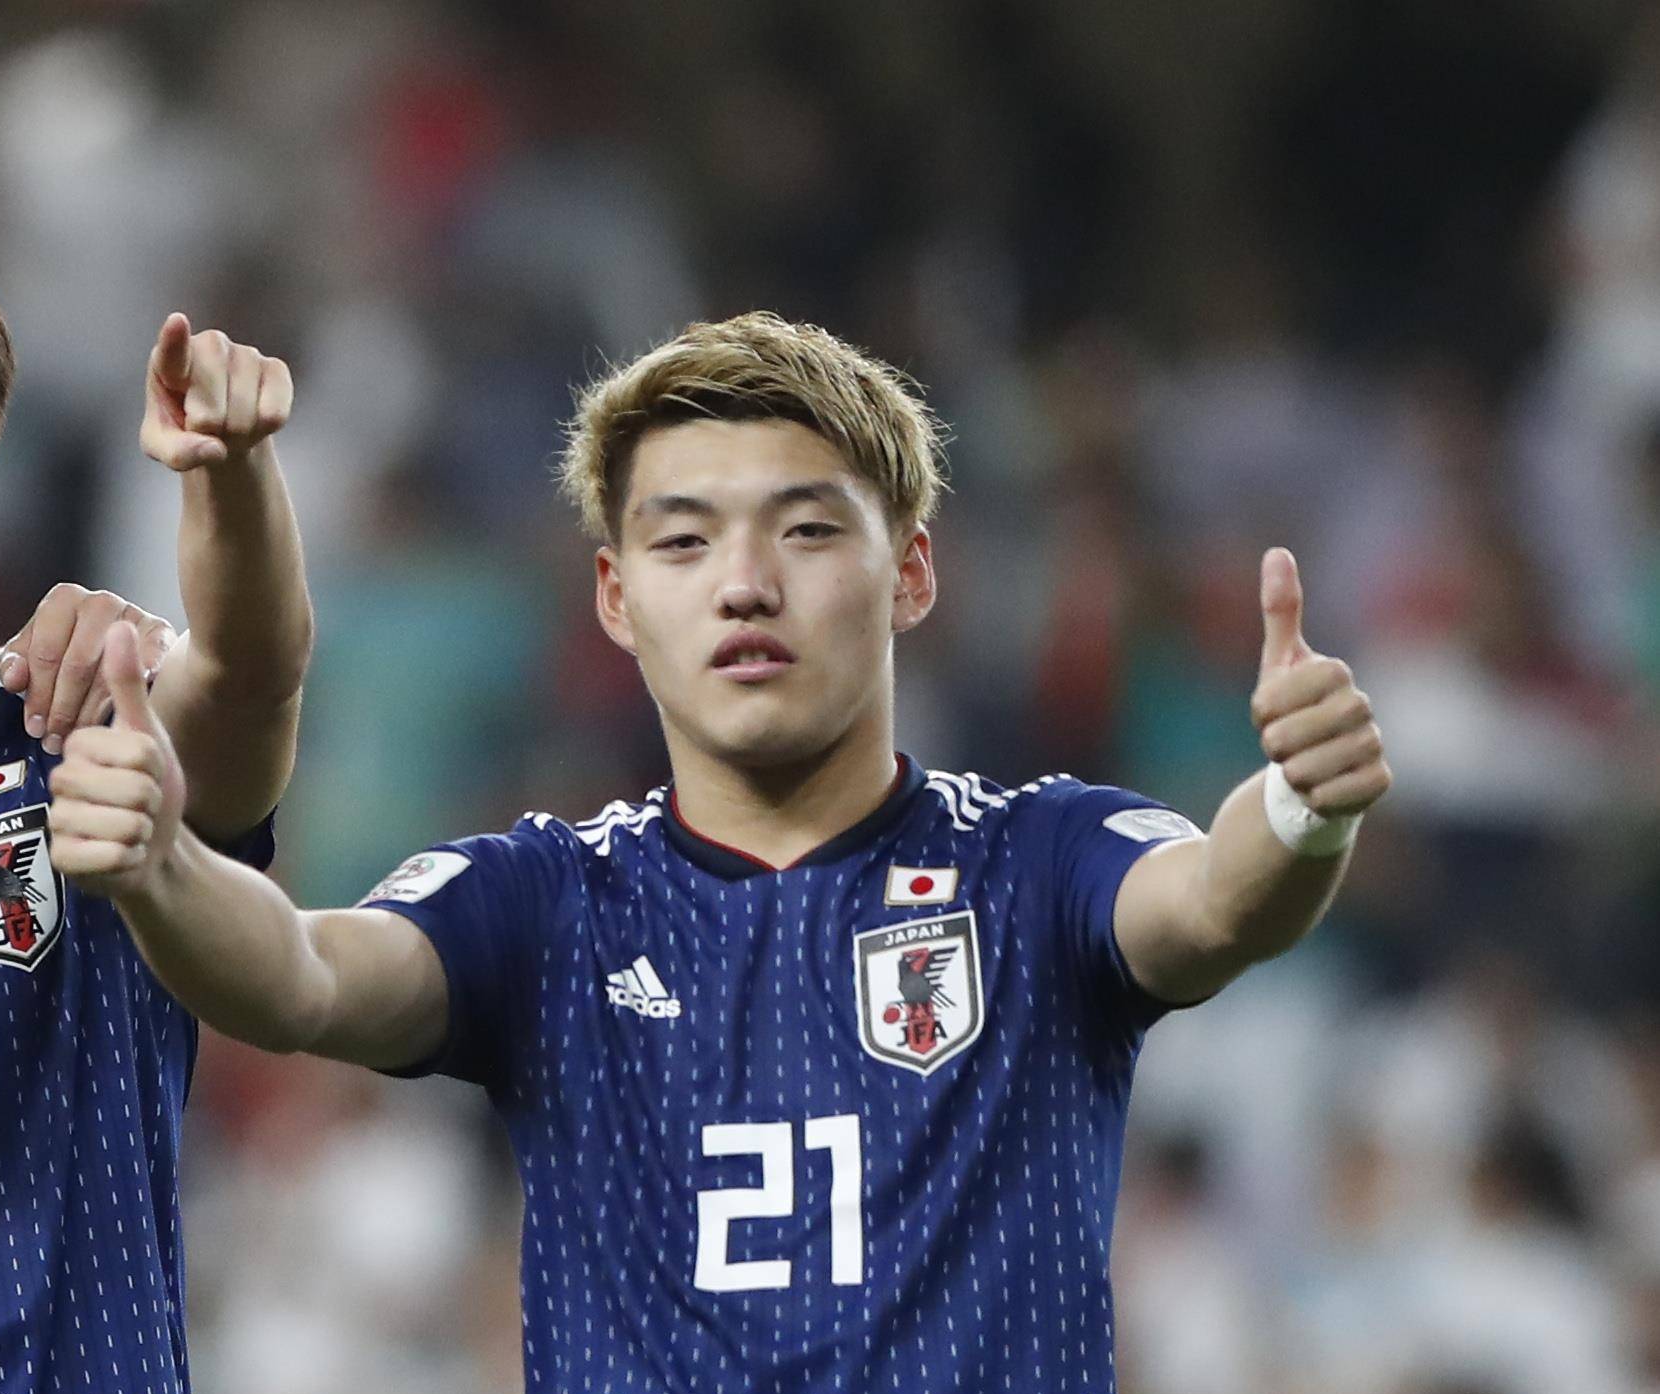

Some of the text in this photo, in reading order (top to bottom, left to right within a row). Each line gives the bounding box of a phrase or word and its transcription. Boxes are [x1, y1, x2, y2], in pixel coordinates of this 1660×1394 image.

[884, 923, 944, 946] JAPAN
[896, 1020, 948, 1047] JFA
[693, 1113, 863, 1292] 21
